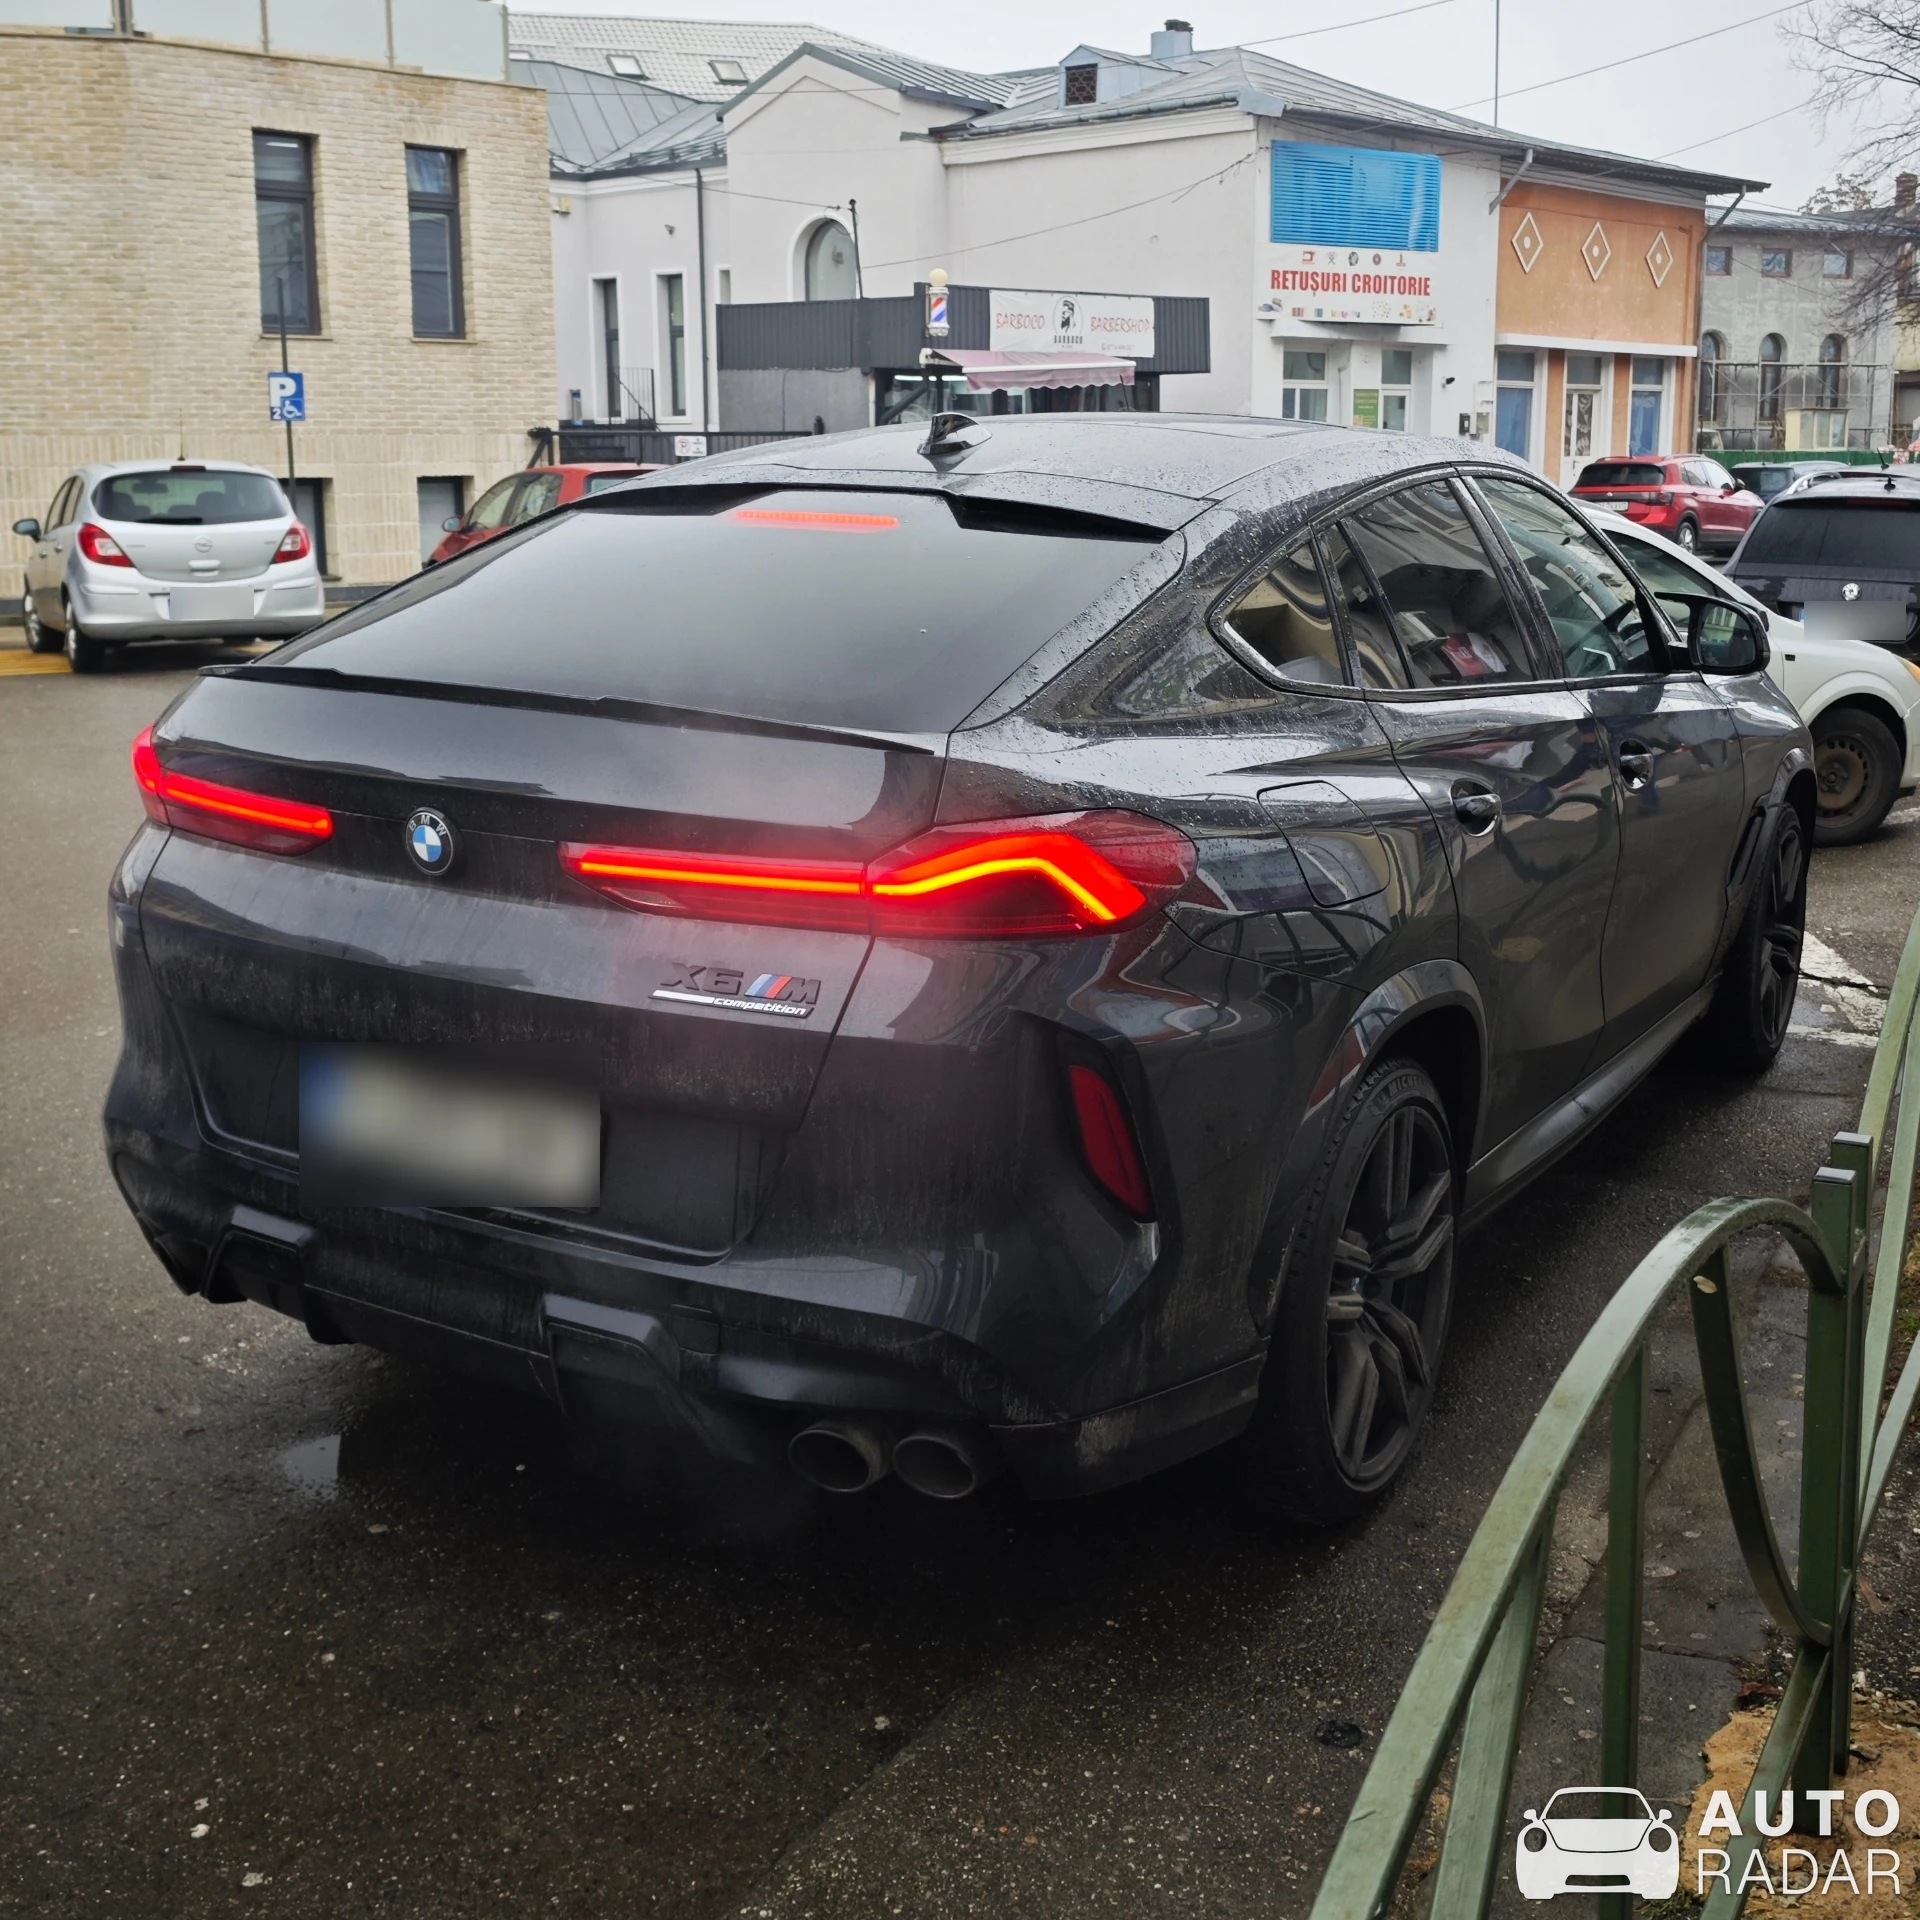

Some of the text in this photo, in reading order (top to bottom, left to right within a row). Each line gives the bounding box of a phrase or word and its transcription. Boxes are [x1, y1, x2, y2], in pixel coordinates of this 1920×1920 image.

[1270, 269, 1431, 297] RETUȘURI CROITORIE
[996, 313, 1151, 333] BARBOCO BARBERSHOP
[269, 377, 297, 407] P
[272, 407, 282, 420] 2
[408, 814, 447, 837] BMW
[713, 997, 807, 1016] competition
